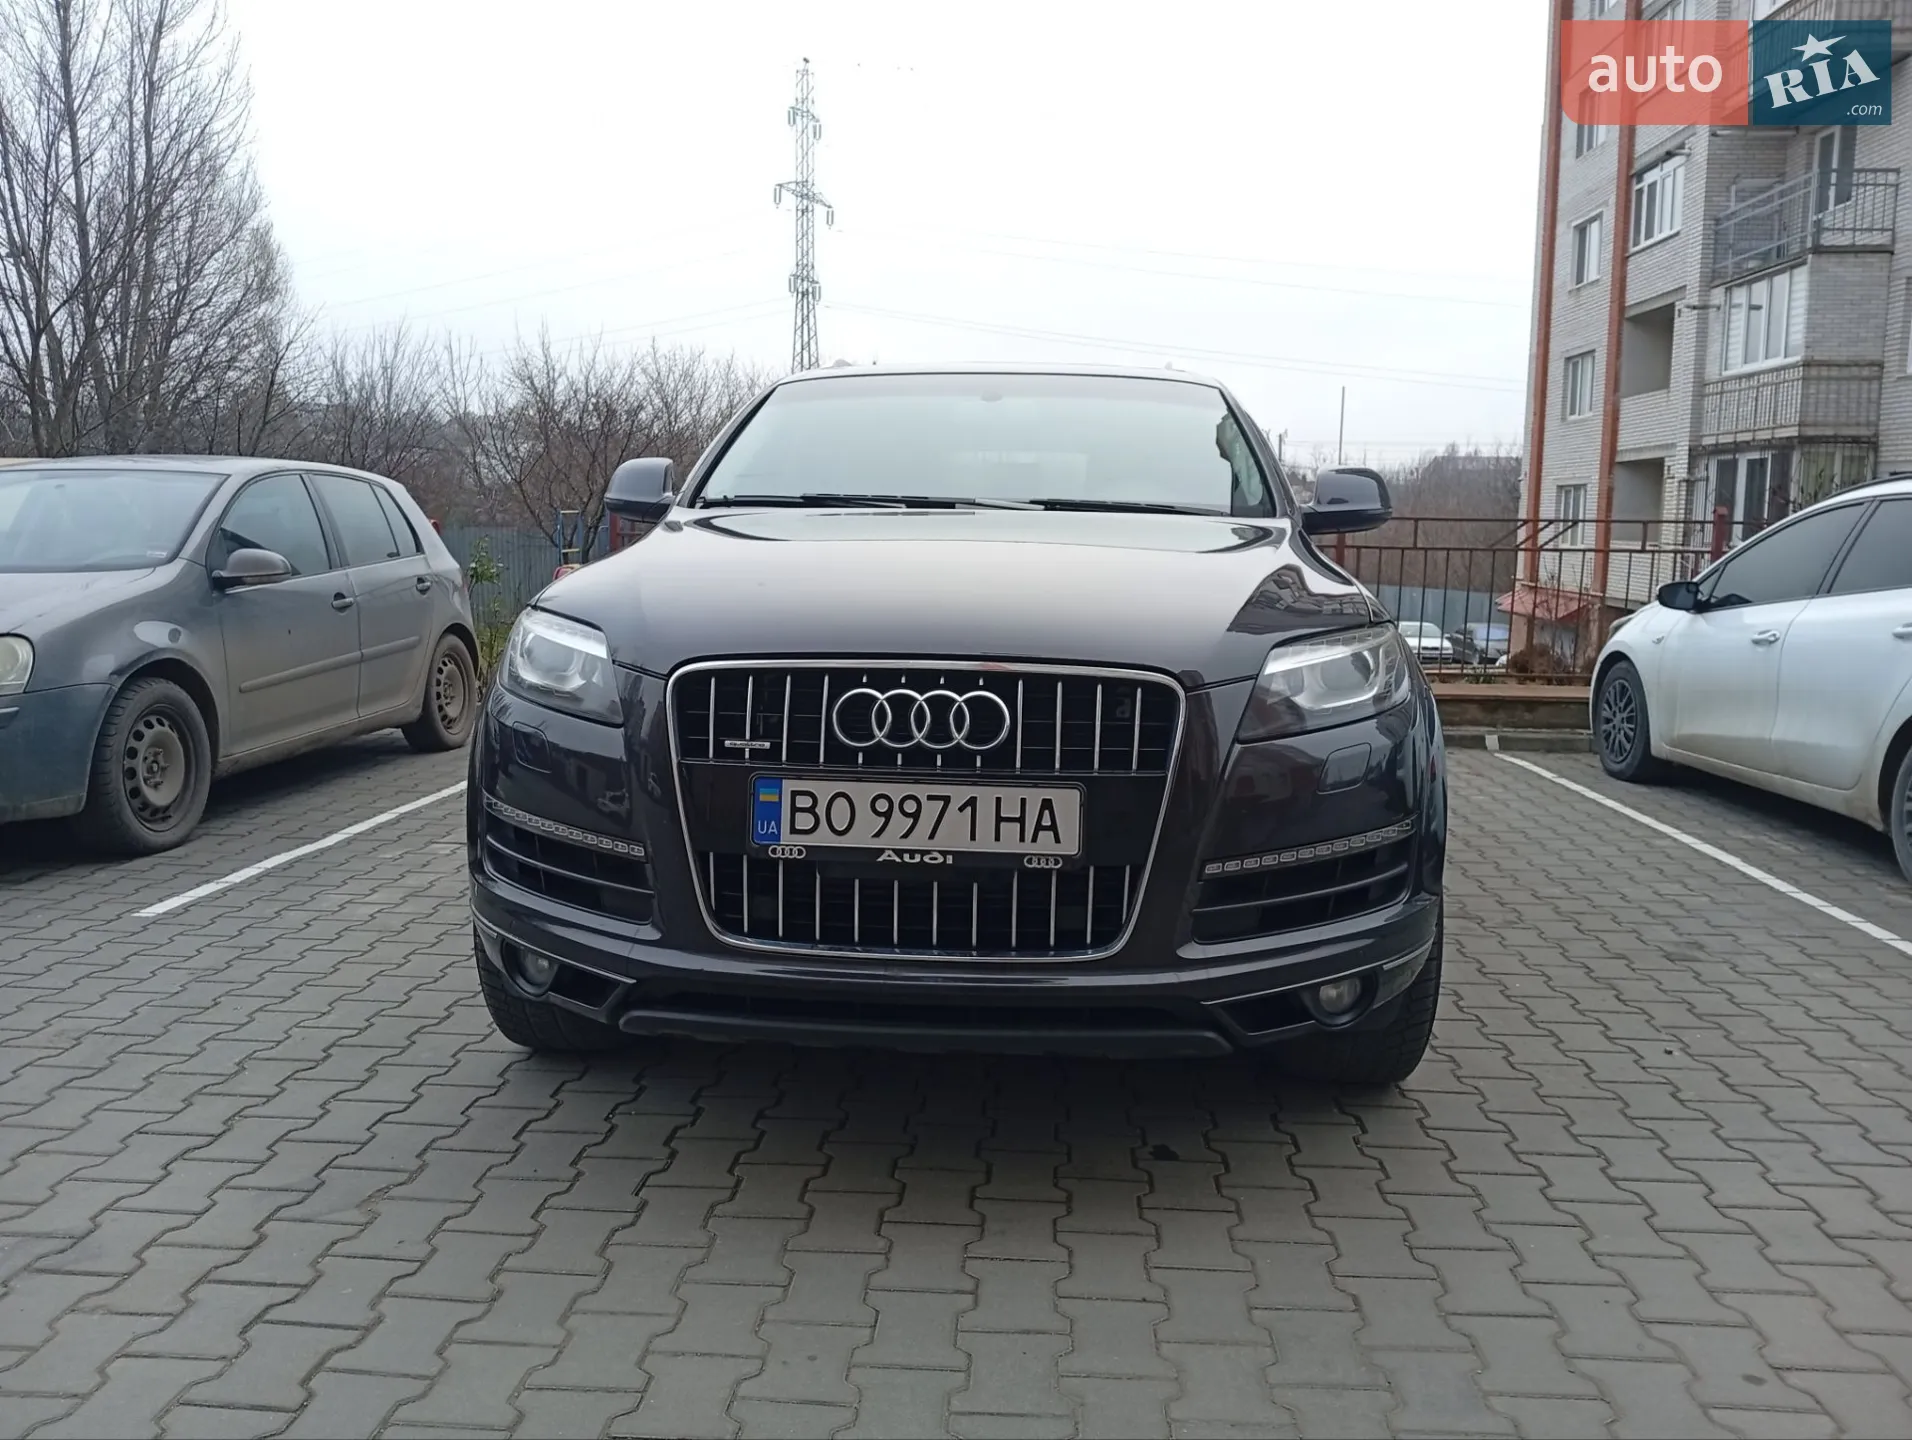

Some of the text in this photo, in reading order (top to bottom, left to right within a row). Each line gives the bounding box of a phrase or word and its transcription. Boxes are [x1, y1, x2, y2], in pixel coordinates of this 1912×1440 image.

[789, 789, 1062, 845] BO 9971 HA
[757, 821, 778, 835] UA
[876, 850, 953, 865] Audi
